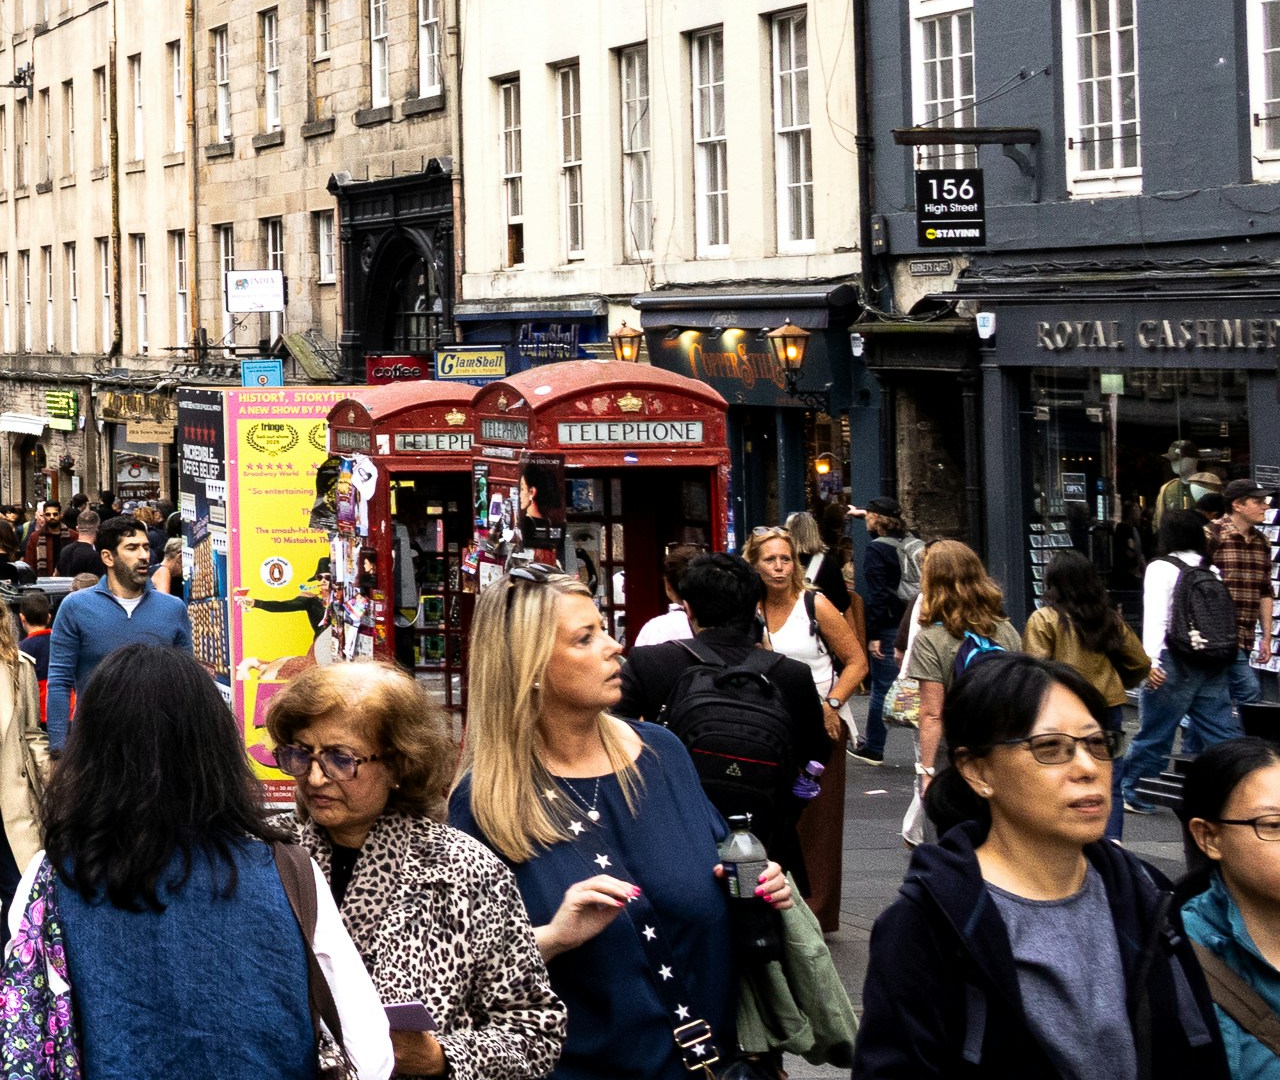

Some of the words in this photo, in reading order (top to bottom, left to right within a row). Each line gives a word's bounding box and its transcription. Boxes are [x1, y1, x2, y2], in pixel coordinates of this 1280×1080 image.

[928, 179, 974, 199] 156
[925, 204, 948, 214] High
[950, 203, 978, 212] Street
[1037, 320, 1124, 350] ROYAL
[441, 354, 503, 375] ClamShell
[372, 364, 422, 379] coffee
[239, 393, 289, 403] HISTORY,
[239, 406, 246, 414] A
[248, 406, 270, 414] NEW
[272, 406, 300, 414] SHOW
[302, 406, 314, 414] BY
[261, 423, 285, 432] fringe
[567, 423, 696, 442] TELEPHONE
[265, 488, 314, 496] entertaining
[272, 526, 309, 534] smash-hit
